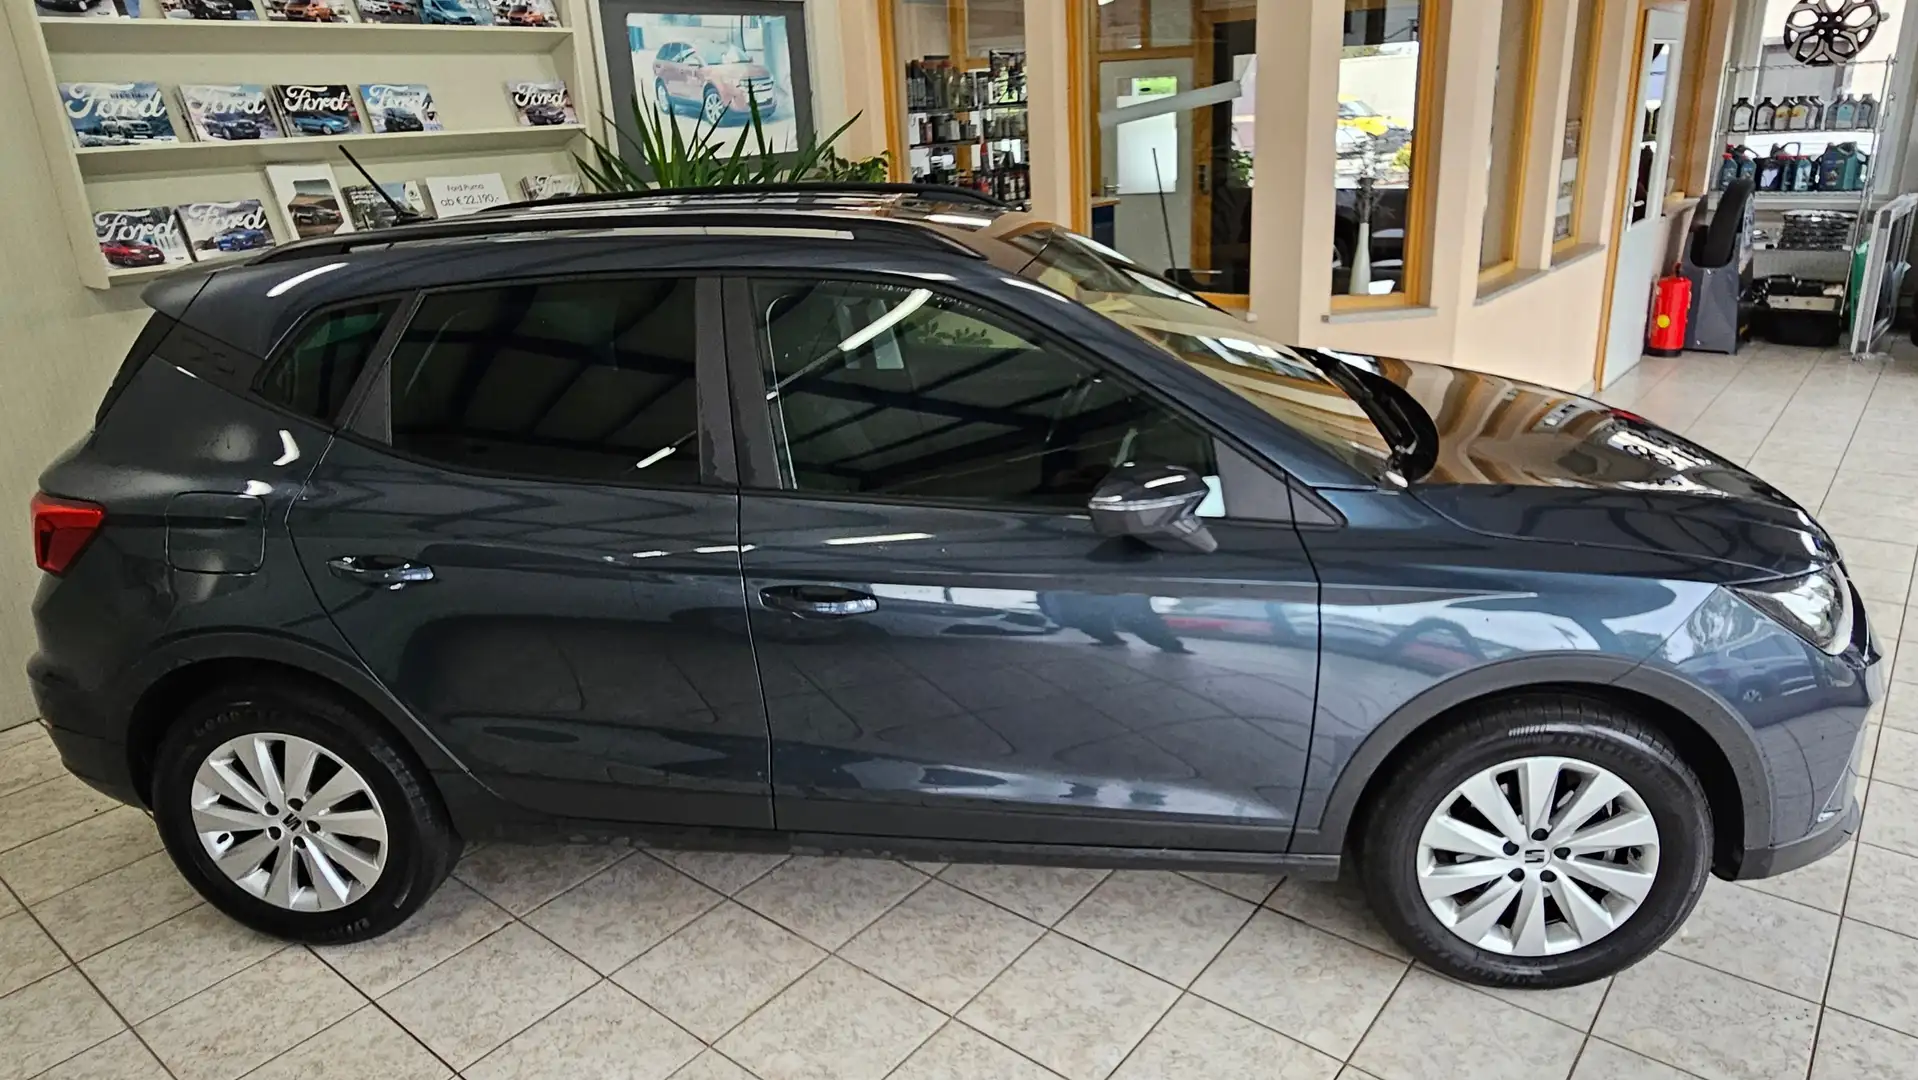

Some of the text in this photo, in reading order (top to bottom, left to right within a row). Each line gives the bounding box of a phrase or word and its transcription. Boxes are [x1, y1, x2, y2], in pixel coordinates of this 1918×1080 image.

[65, 83, 166, 118] Ford
[185, 85, 266, 114] Ford
[284, 86, 348, 112] Ford
[515, 82, 567, 107] Ford
[440, 197, 455, 207] ab
[95, 210, 179, 243] Ford
[187, 201, 267, 236] Ford
